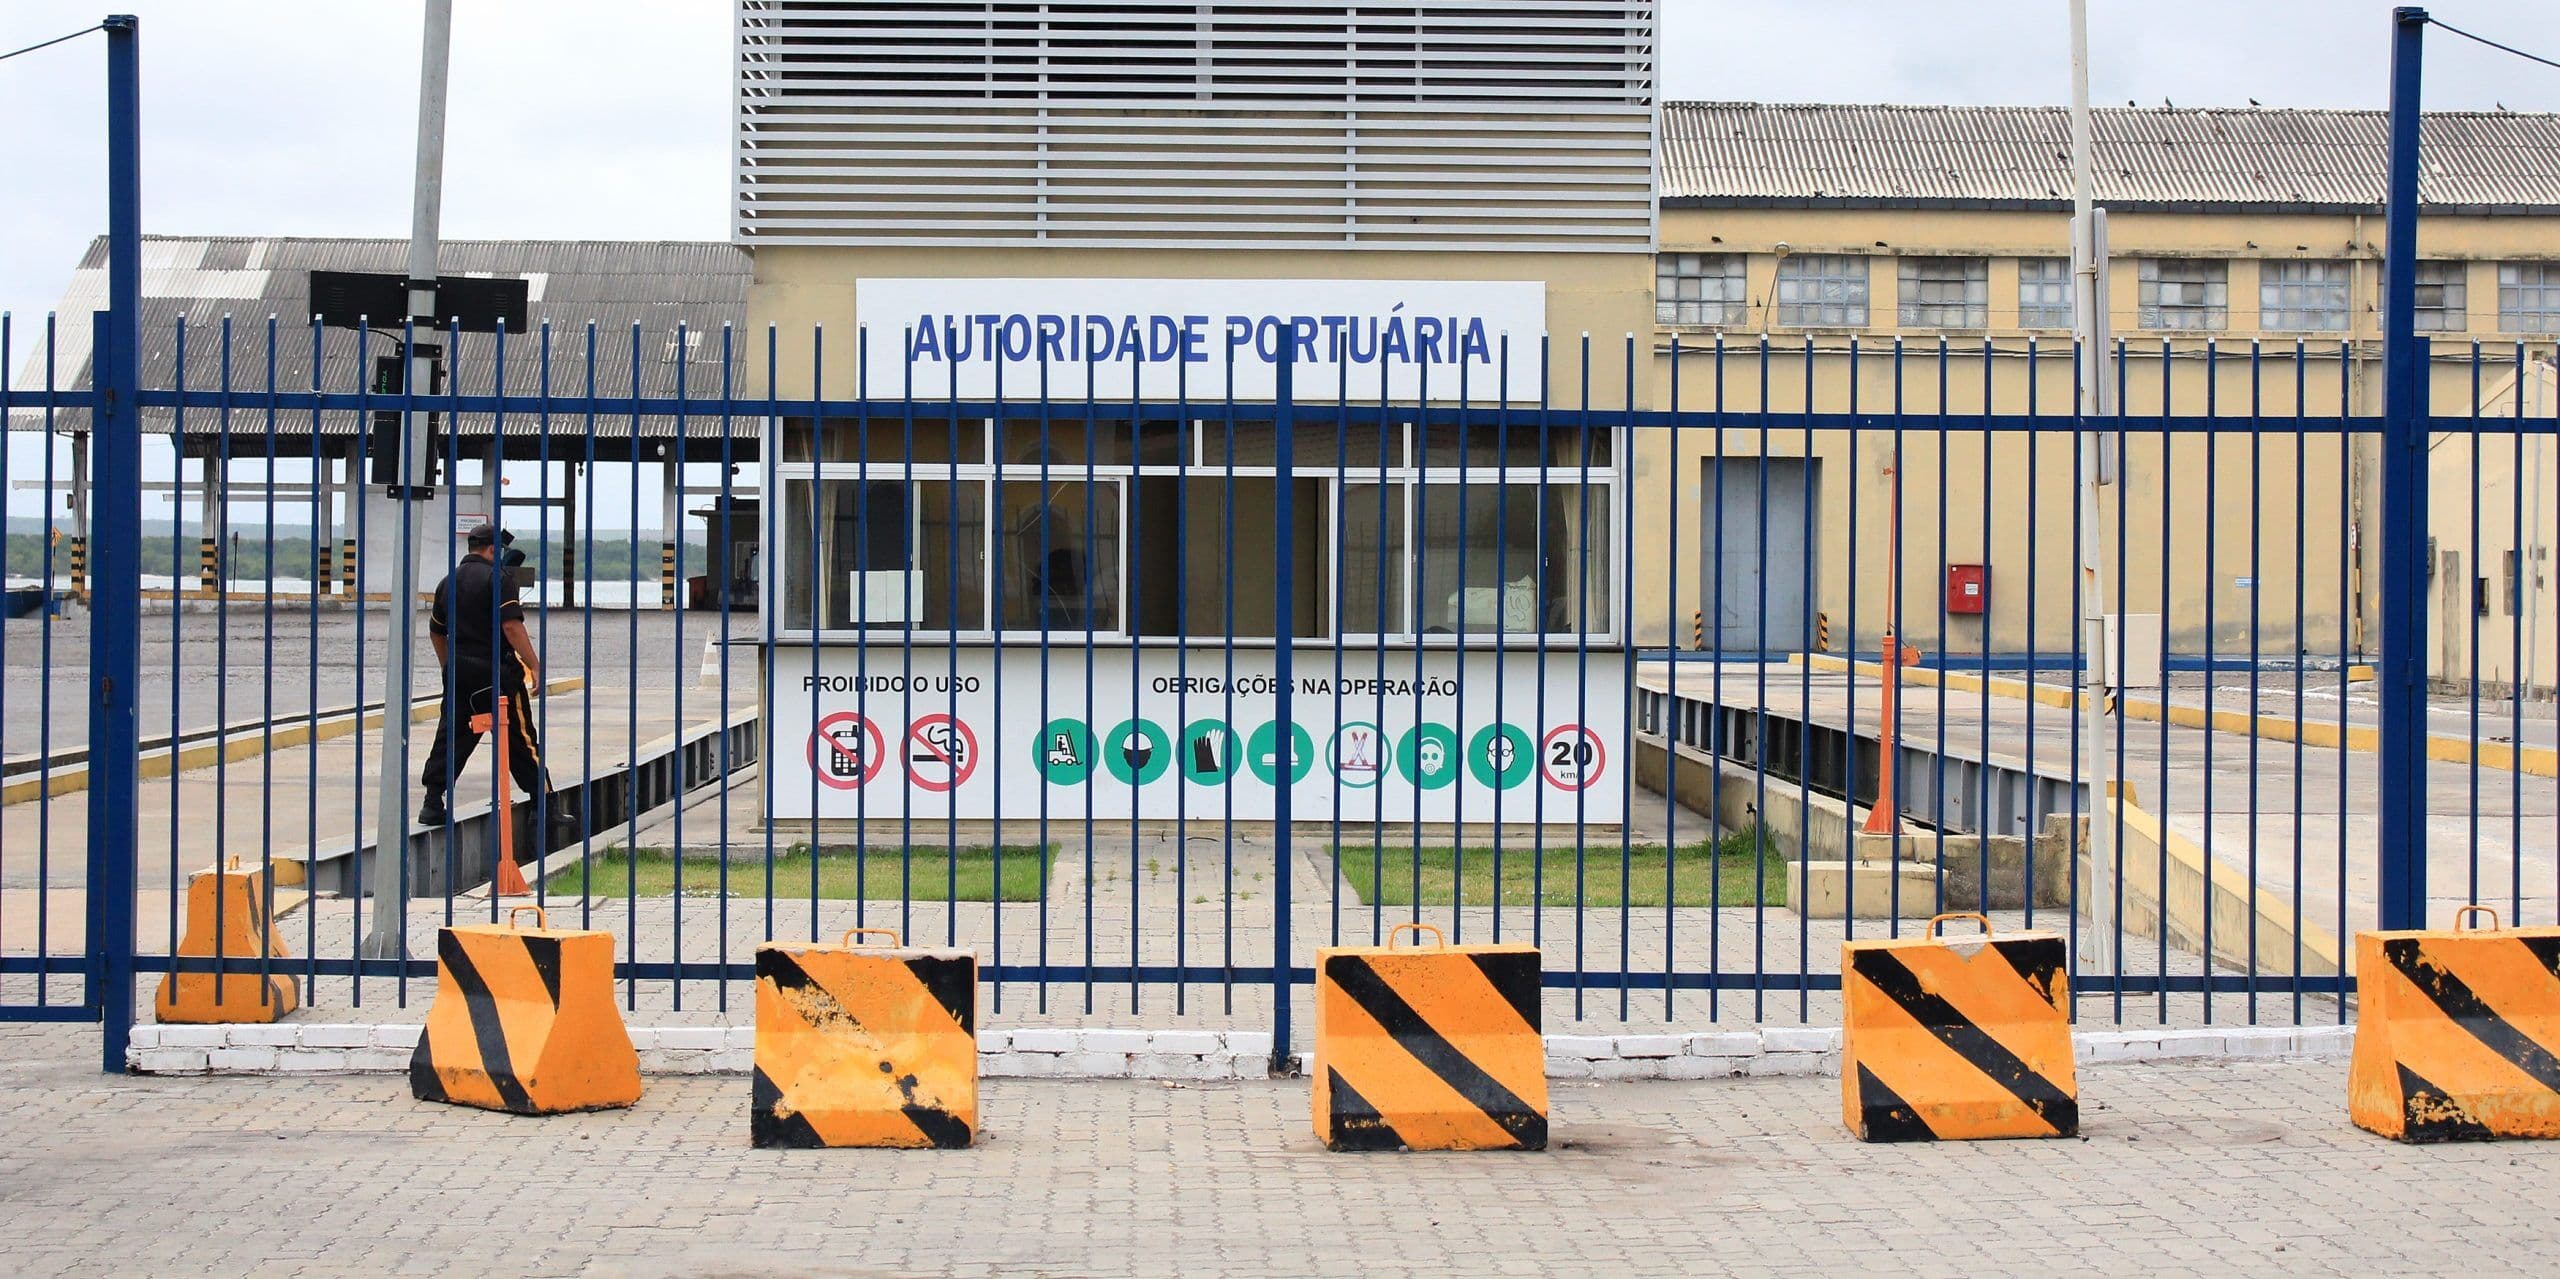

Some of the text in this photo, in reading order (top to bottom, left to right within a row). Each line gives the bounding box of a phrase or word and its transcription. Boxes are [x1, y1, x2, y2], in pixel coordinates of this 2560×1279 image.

[911, 301, 1491, 364] AUTORIDADE PORTUÁRIA
[803, 676, 980, 692] PROIBIDO O USO
[1152, 674, 1295, 698] OBRIGAÇÕE
[1302, 678, 1332, 695] NA
[1551, 741, 1593, 766] 20
[1560, 770, 1586, 779] km
